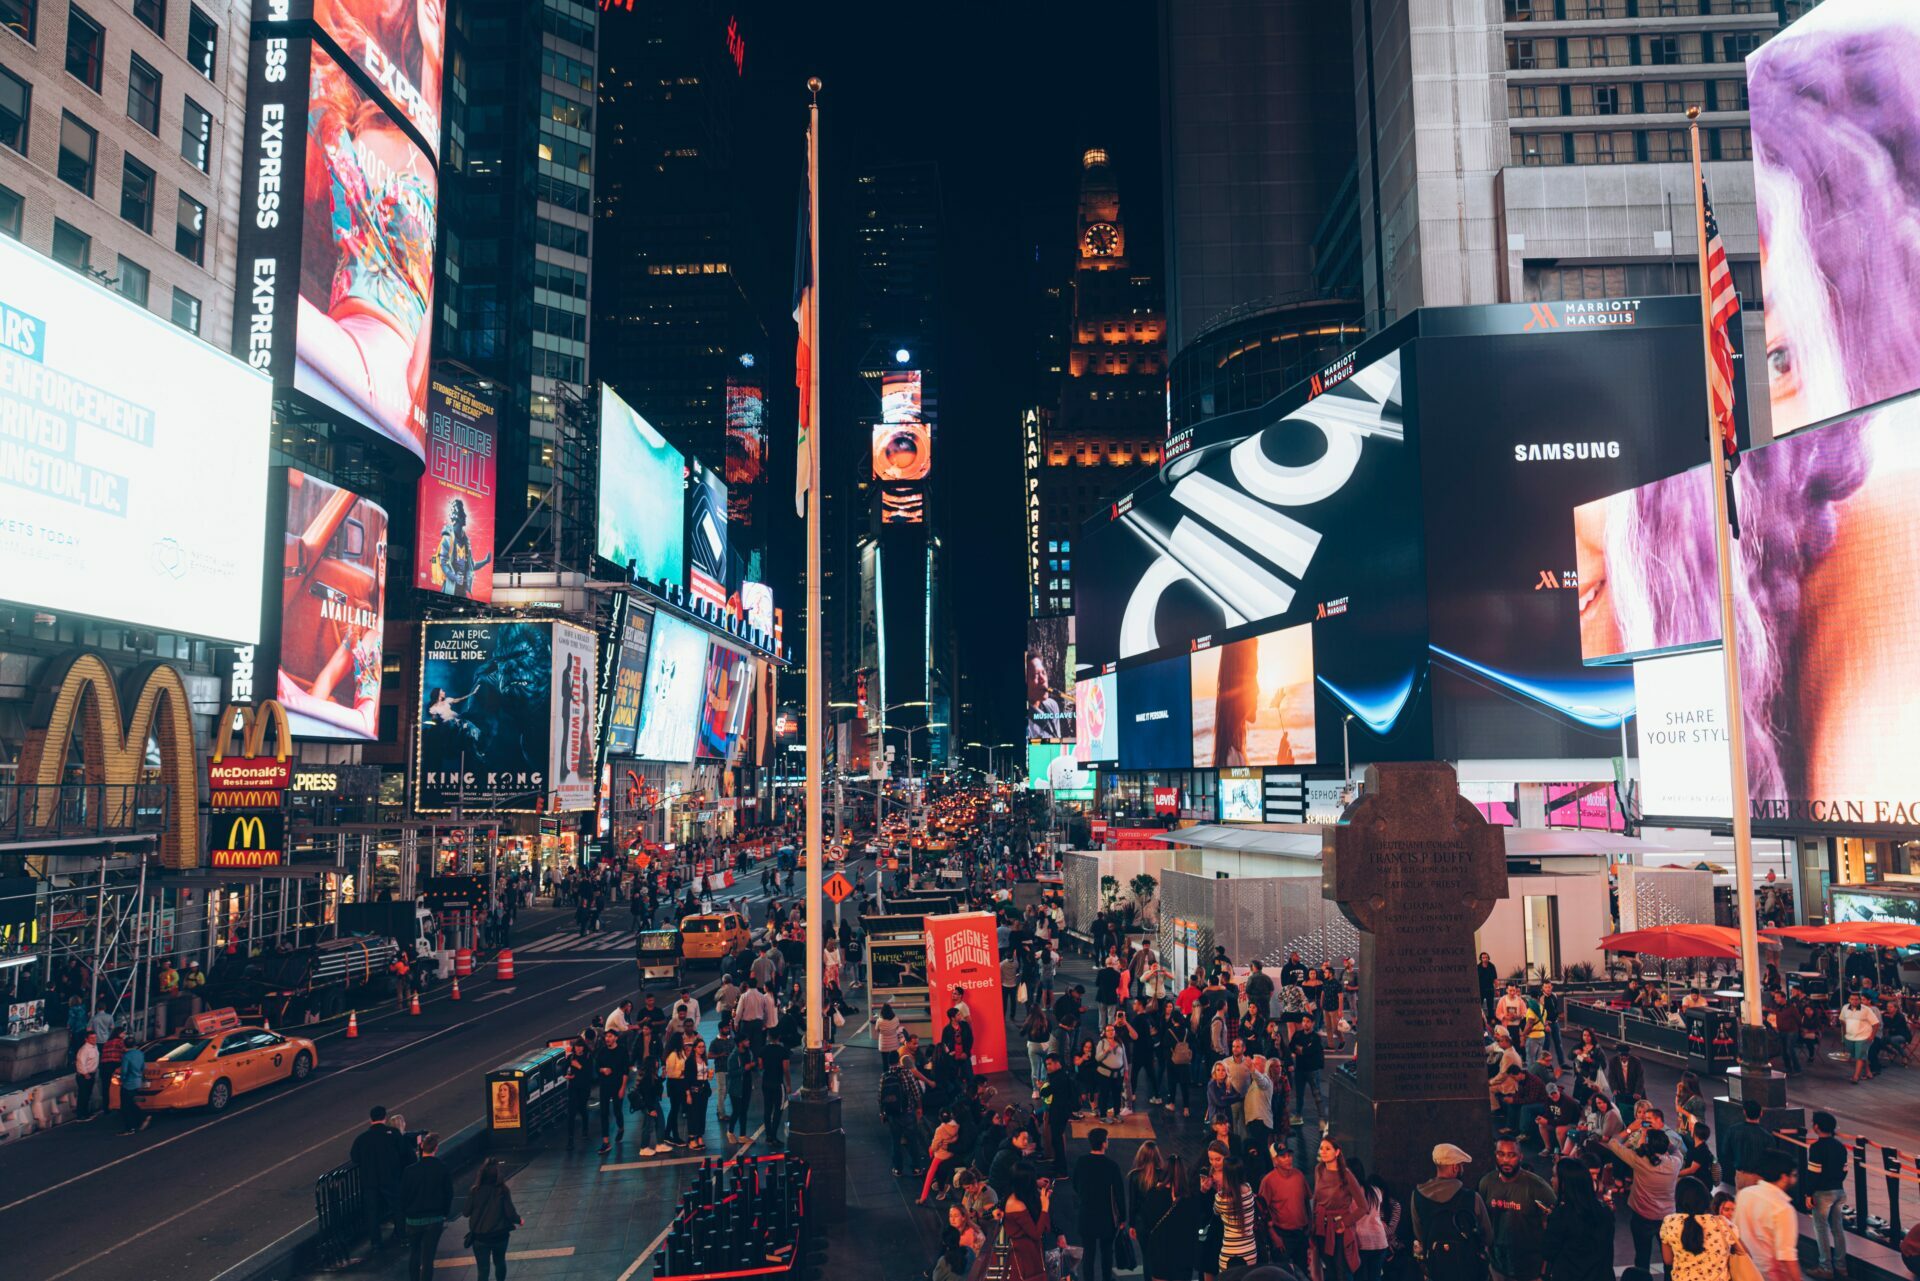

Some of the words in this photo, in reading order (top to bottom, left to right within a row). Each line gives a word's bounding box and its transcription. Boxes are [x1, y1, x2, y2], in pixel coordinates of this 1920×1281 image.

[256, 103, 285, 230] EXPRESS
[1566, 300, 1641, 313] MARRIOTT
[1566, 313, 1633, 325] MARQUIS
[1323, 350, 1357, 377] MARRIOTT
[1323, 365, 1354, 389] MARQUIS
[0, 358, 149, 442] ENFORCEMENT
[433, 412, 451, 441] BE
[454, 421, 492, 457] MORE
[1025, 409, 1039, 470] ALAN
[1166, 428, 1194, 449] MARRIOTT
[1166, 440, 1191, 460] MARQUIS
[1514, 441, 1620, 462] SAMSUNG
[431, 437, 490, 496] CHILL
[39, 527, 81, 546] TODAY
[319, 599, 377, 630] AVAILABLE
[434, 640, 479, 650] DAZZLING
[428, 651, 458, 660] THRILL
[613, 705, 638, 728] AWAY
[1033, 712, 1055, 720] MUSIC
[1666, 708, 1715, 725] SHARE
[1647, 731, 1686, 745] YOUR
[1692, 728, 1730, 743] STYL
[211, 767, 287, 779] McDonald's
[427, 772, 476, 785] KING
[487, 772, 543, 785] KONG
[1369, 852, 1418, 863] FRANCIS
[1433, 852, 1474, 863] DUFFY
[944, 929, 981, 954] DESIGN
[872, 951, 903, 965] Forge
[945, 946, 992, 971] PAVILION
[946, 977, 994, 992] solstreet
